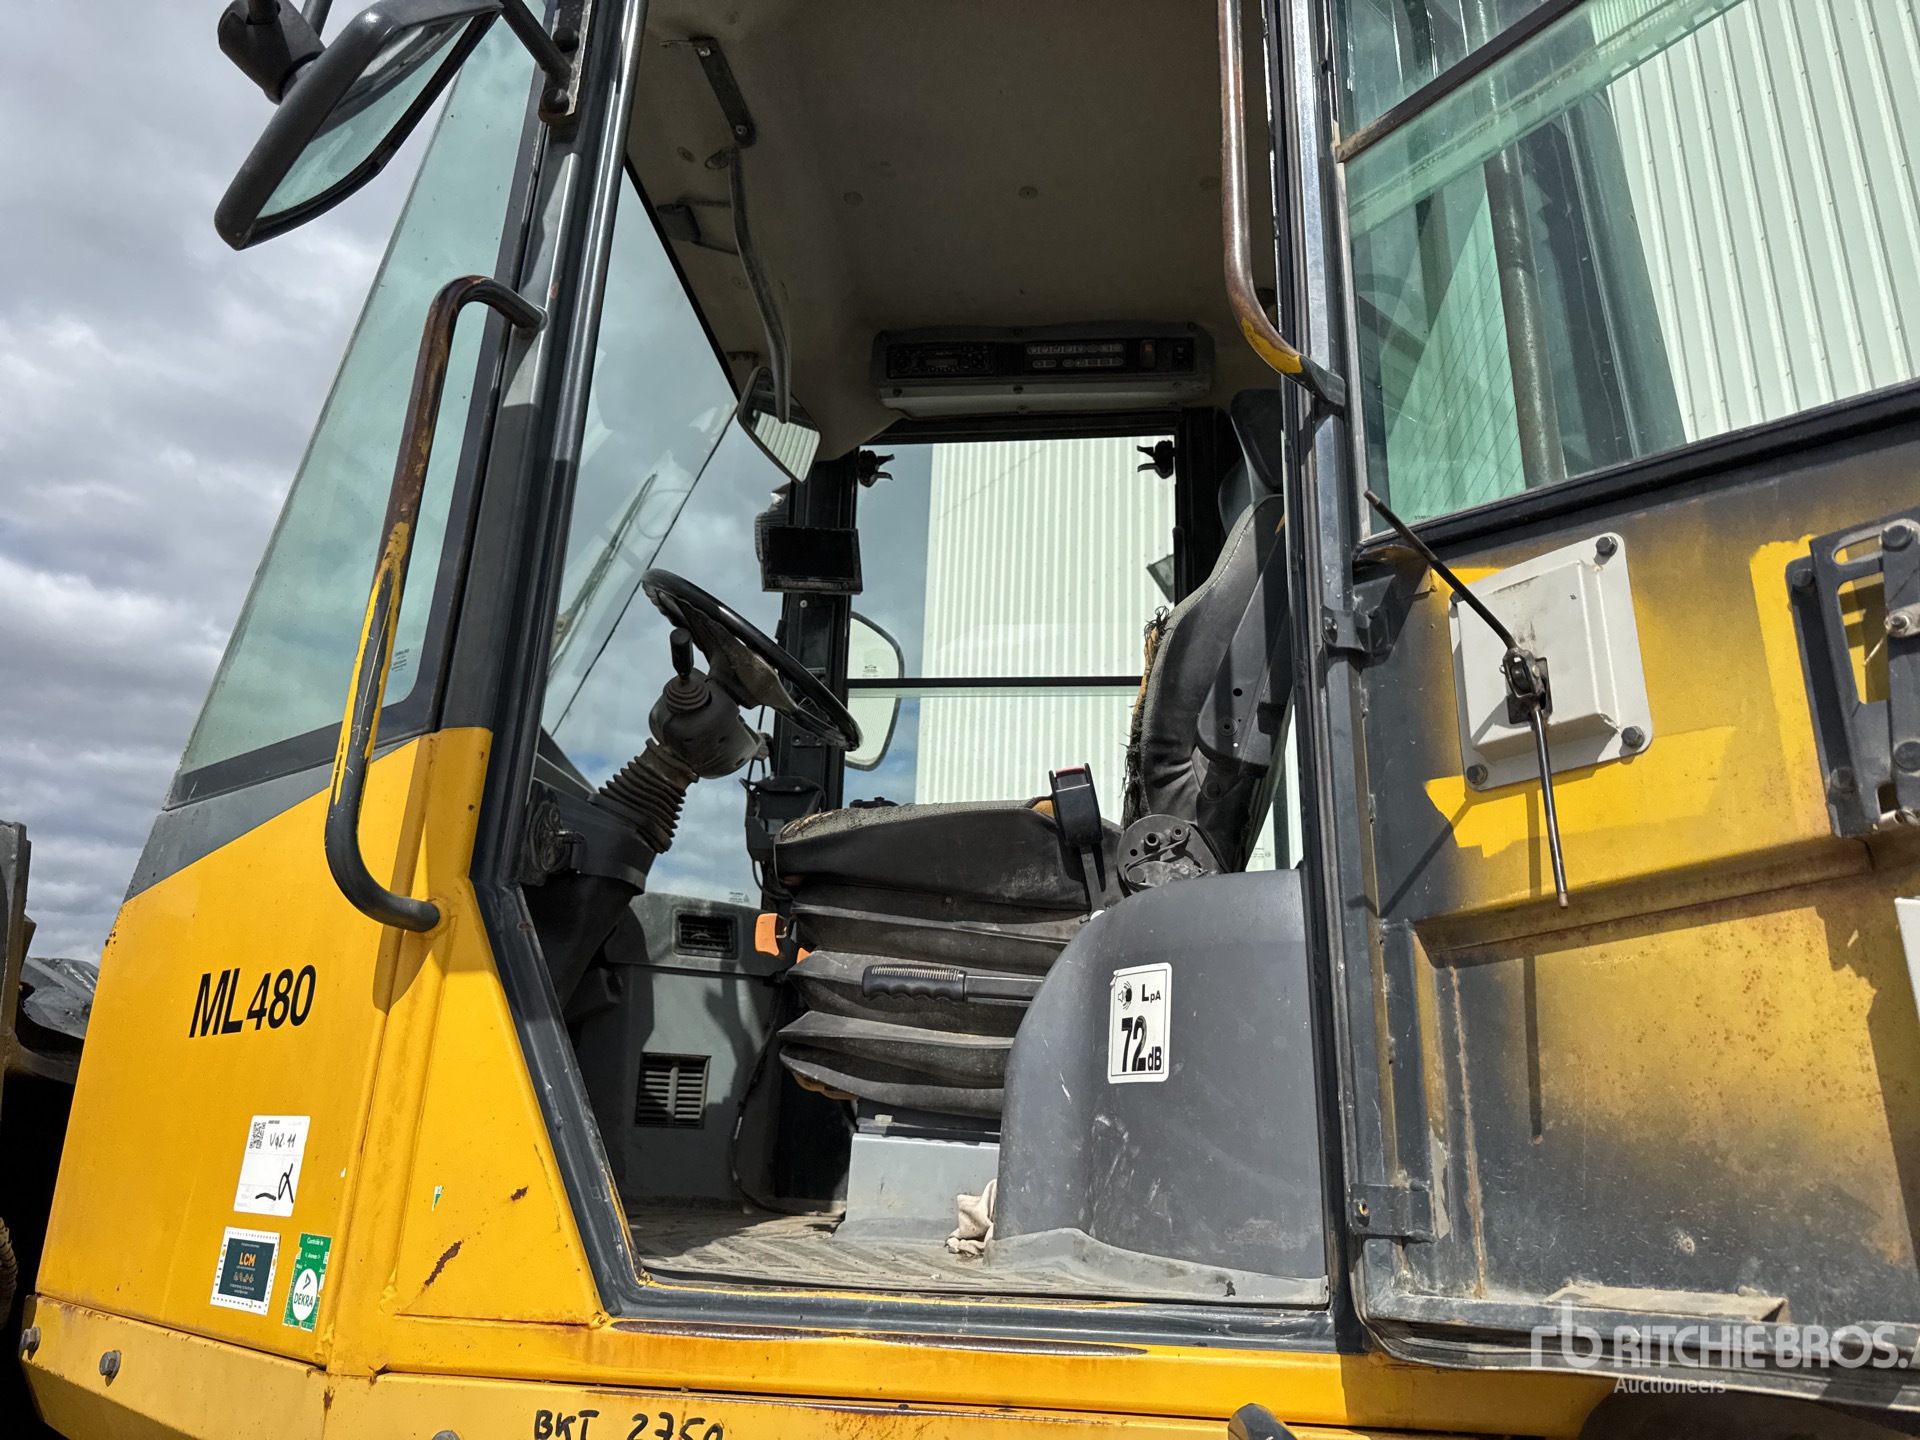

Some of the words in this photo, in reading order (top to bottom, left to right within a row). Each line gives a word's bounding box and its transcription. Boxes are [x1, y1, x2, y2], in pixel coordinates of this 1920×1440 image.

[188, 964, 316, 1039] ML480
[239, 1252, 257, 1267] LCM
[293, 1292, 313, 1308] DEKRA
[533, 1409, 600, 1440] BKT
